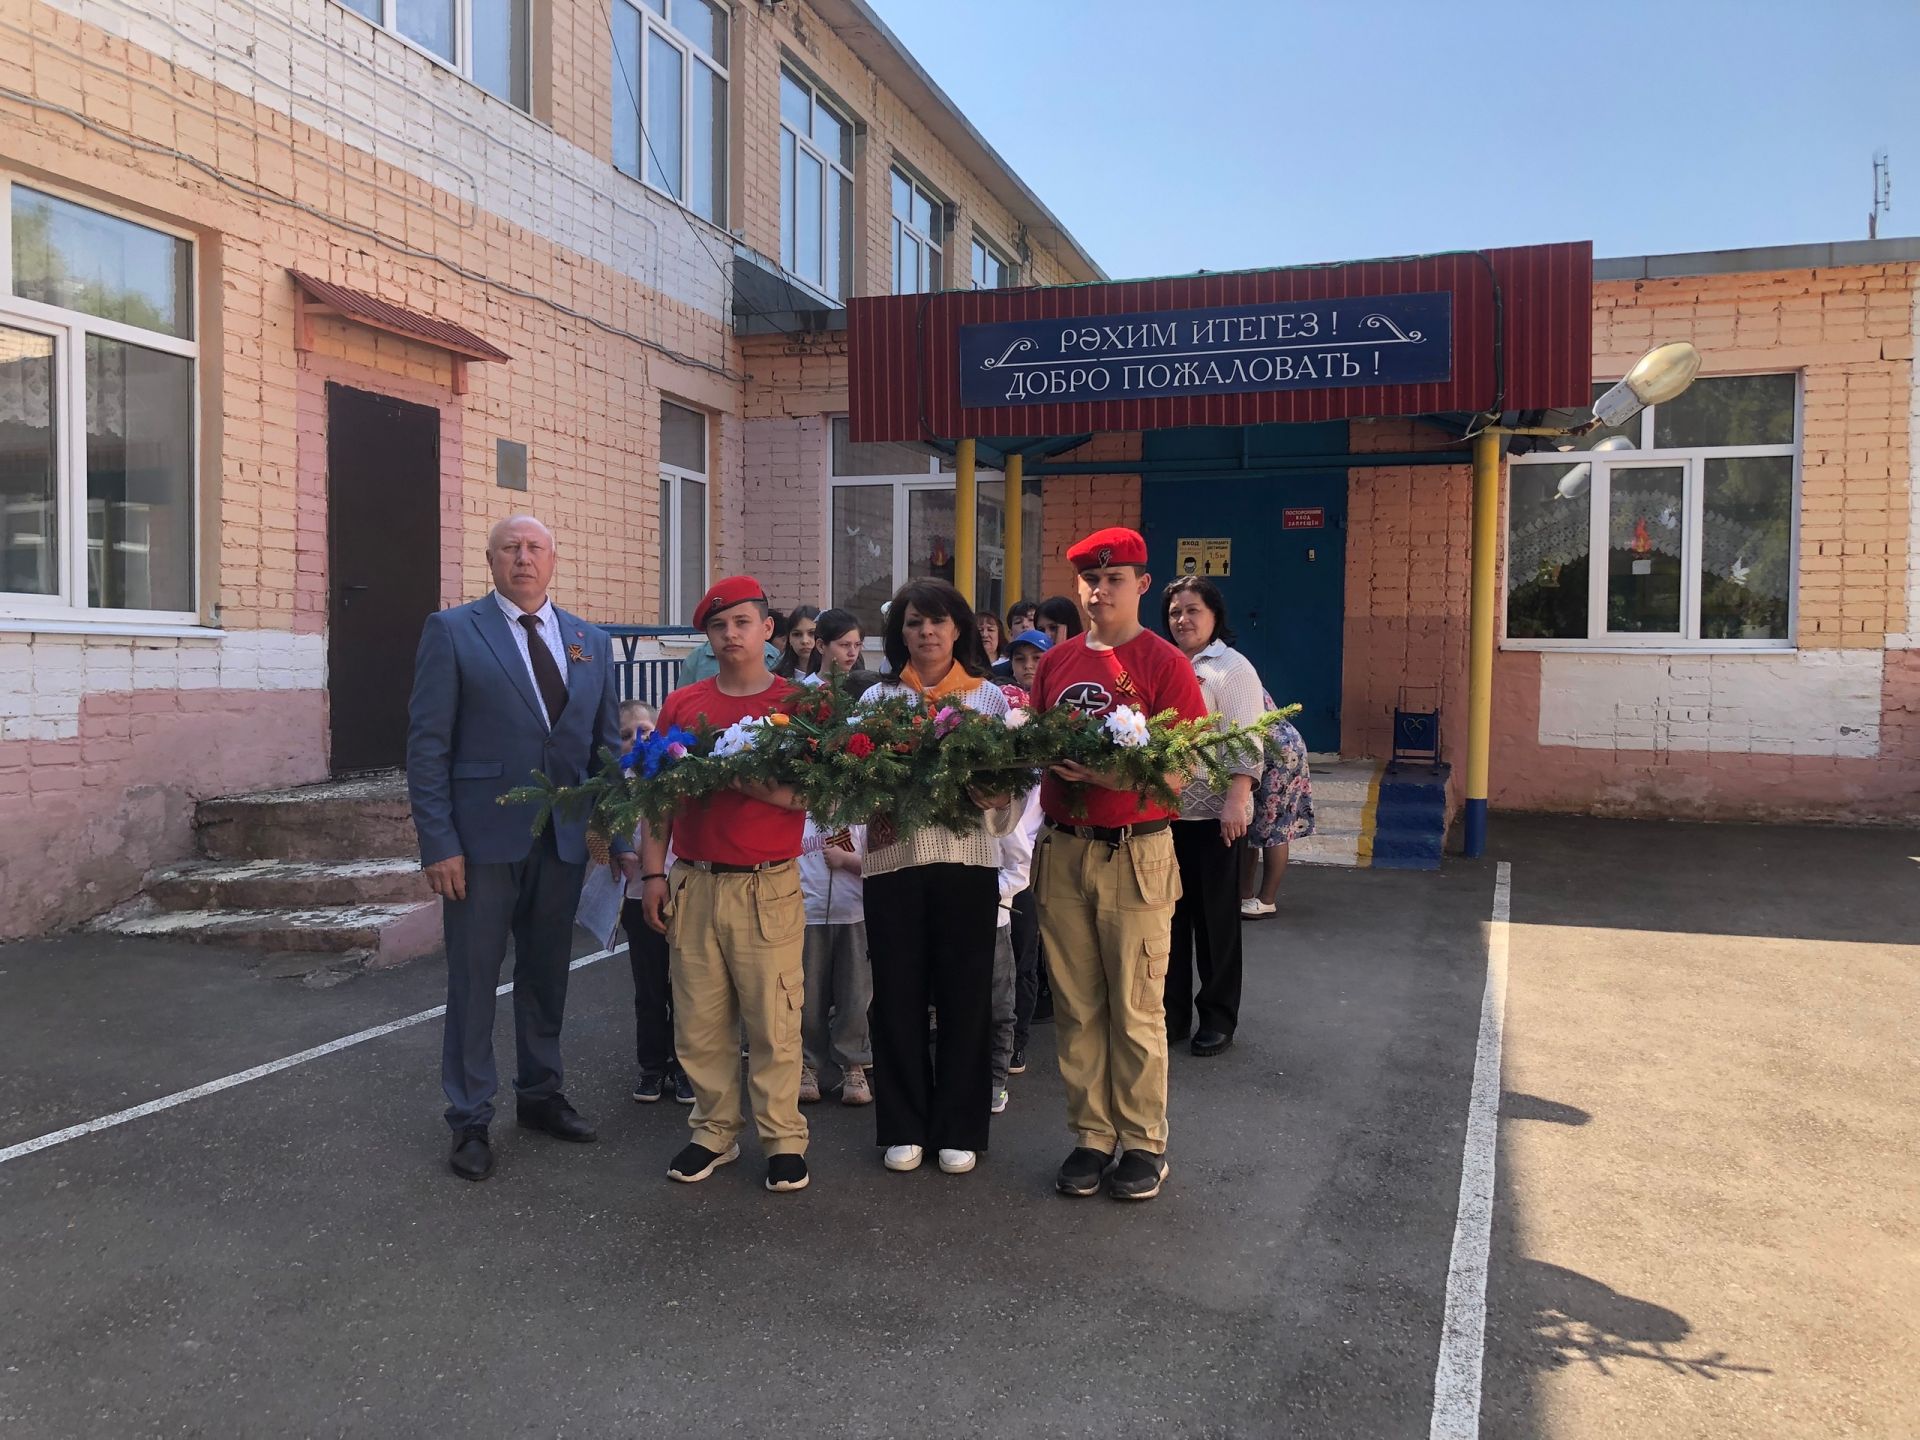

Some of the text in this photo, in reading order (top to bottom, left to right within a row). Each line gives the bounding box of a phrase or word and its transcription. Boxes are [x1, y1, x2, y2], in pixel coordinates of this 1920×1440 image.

[1059, 321, 1177, 353] РӘХИМ
[1191, 311, 1320, 345] ИТЕГЕЗ
[1005, 366, 1110, 400] ДОБРО
[1122, 352, 1361, 390] ПОЖАЛОВАТЬ
